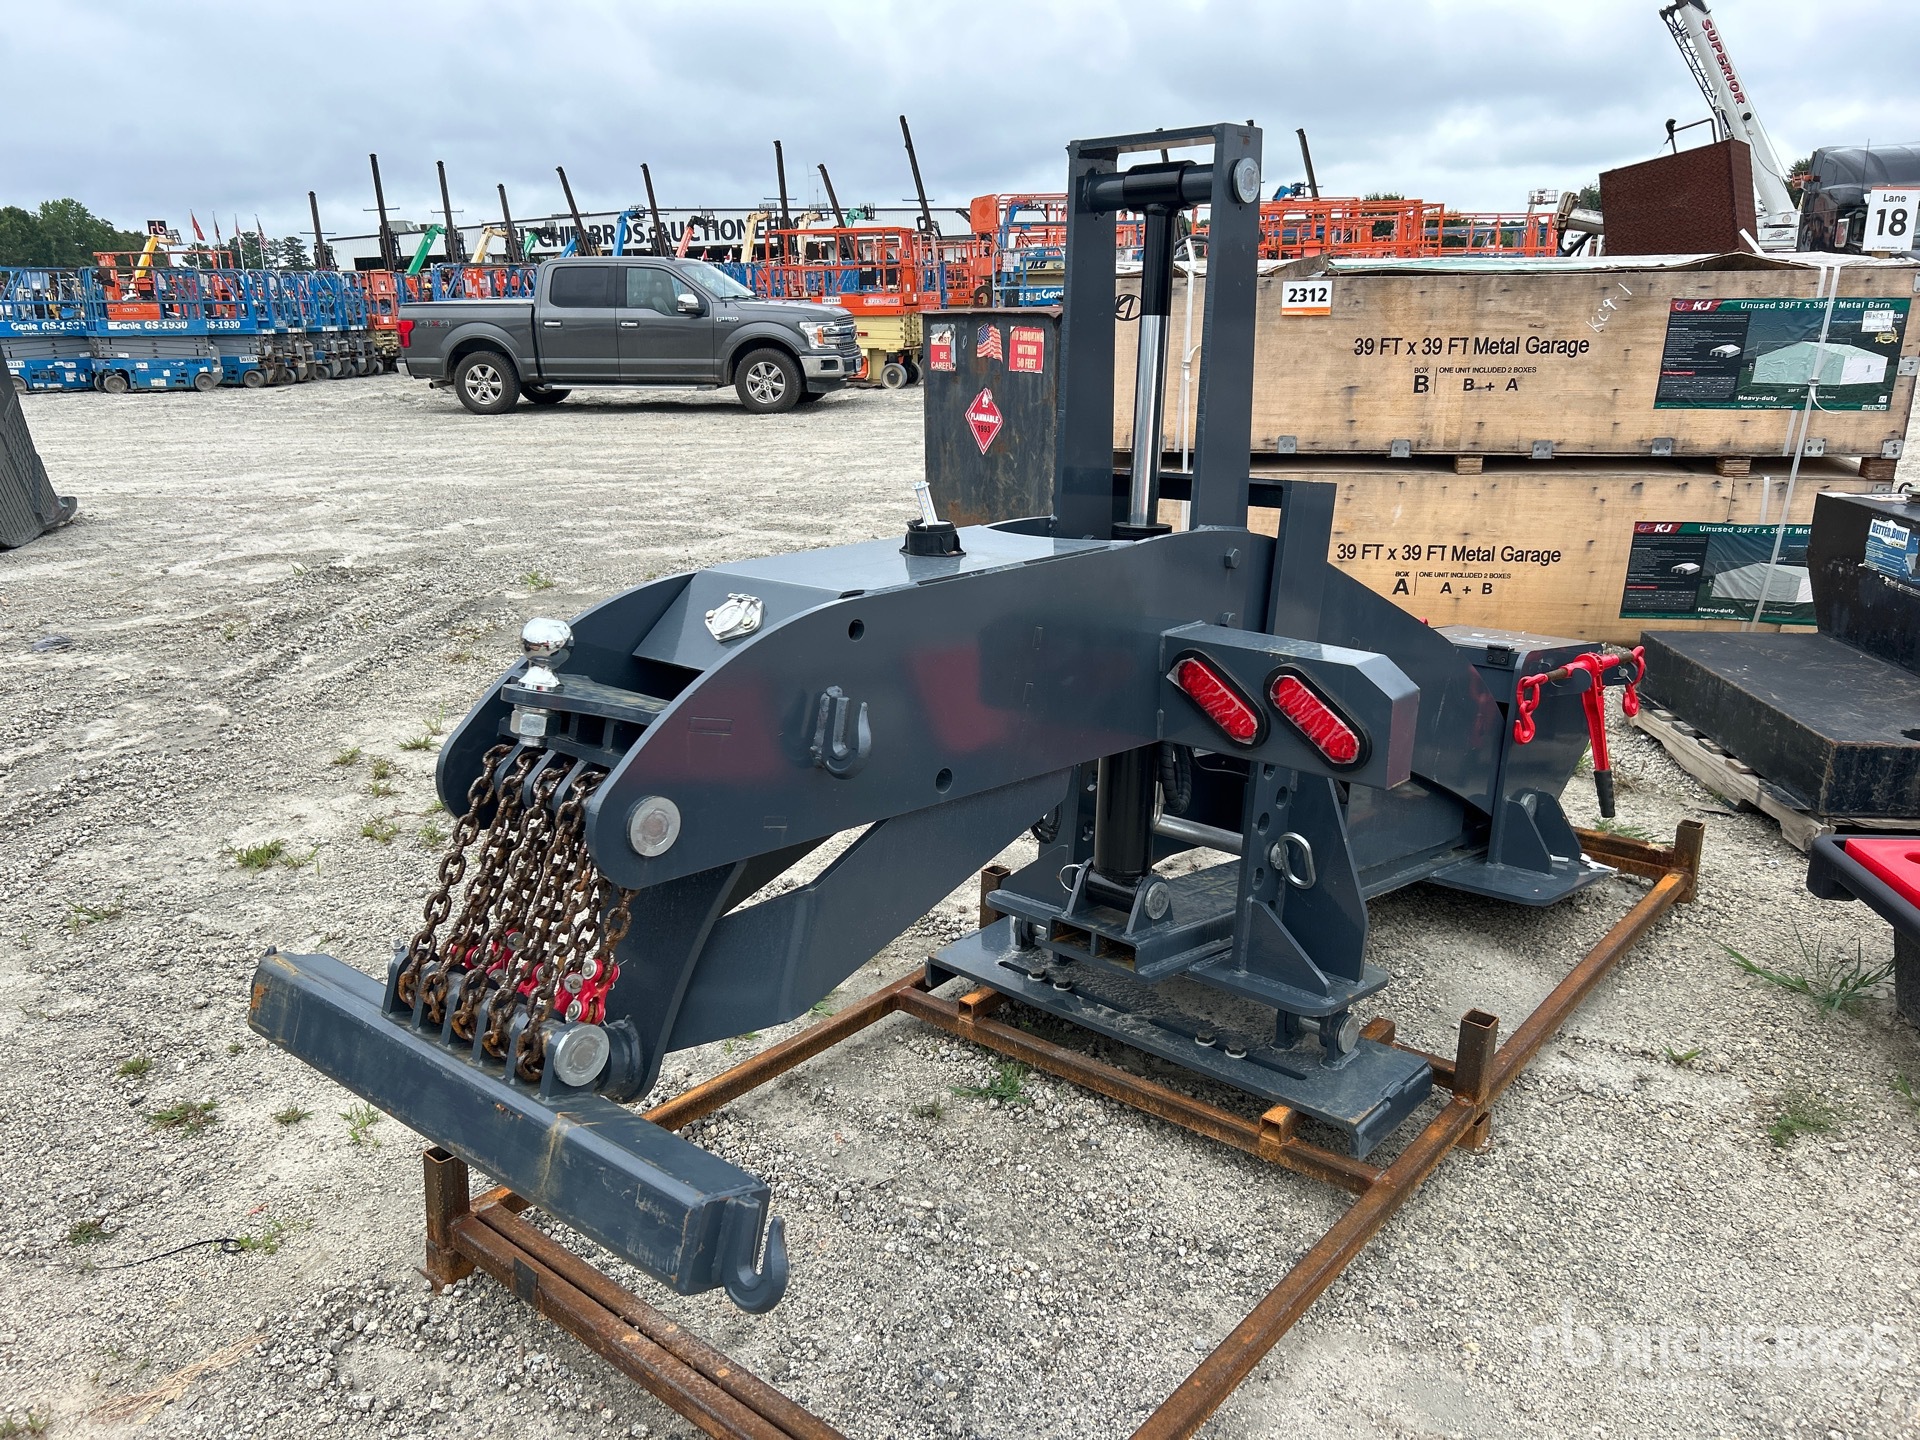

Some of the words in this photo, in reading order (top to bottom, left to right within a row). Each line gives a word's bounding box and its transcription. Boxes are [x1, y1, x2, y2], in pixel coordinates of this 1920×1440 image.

[1702, 19, 1745, 104] SUPERIOR
[1883, 194, 1906, 202] Lane
[1876, 208, 1908, 236] 18
[150, 222, 165, 234] rb
[1028, 261, 1048, 269] JLG
[1042, 289, 1064, 299] Geni
[1288, 288, 1327, 302] 2312
[1692, 301, 1712, 310] KJ
[10, 322, 38, 331] Genie
[145, 321, 188, 329] GS-1930
[1020, 331, 1044, 342] SMOKING
[1017, 346, 1037, 355] WITHIN
[1354, 338, 1375, 355] 39
[1380, 338, 1403, 355] FT
[1407, 342, 1416, 355] x
[1422, 338, 1442, 355] 39
[1448, 337, 1469, 355] FT
[1474, 336, 1520, 355] Metal
[1525, 336, 1590, 358] Garage
[1017, 358, 1024, 367] 50
[1025, 358, 1036, 368] FEET
[1413, 375, 1429, 393] B
[1463, 378, 1475, 391] B
[1506, 378, 1518, 391] A
[970, 413, 999, 423] FLAMMABLE
[978, 425, 991, 433] 1993
[1654, 524, 1672, 532] KJ
[1872, 522, 1891, 537] BETTER
[1336, 544, 1357, 560] 39
[1361, 544, 1384, 560] FT
[1387, 548, 1396, 560] x
[1401, 545, 1422, 560] 39
[1426, 545, 1447, 561] FT
[1451, 545, 1496, 562] Metal
[1500, 546, 1562, 566] Garage
[1392, 579, 1410, 595] A
[1440, 582, 1452, 594] A
[1482, 583, 1493, 594] B
